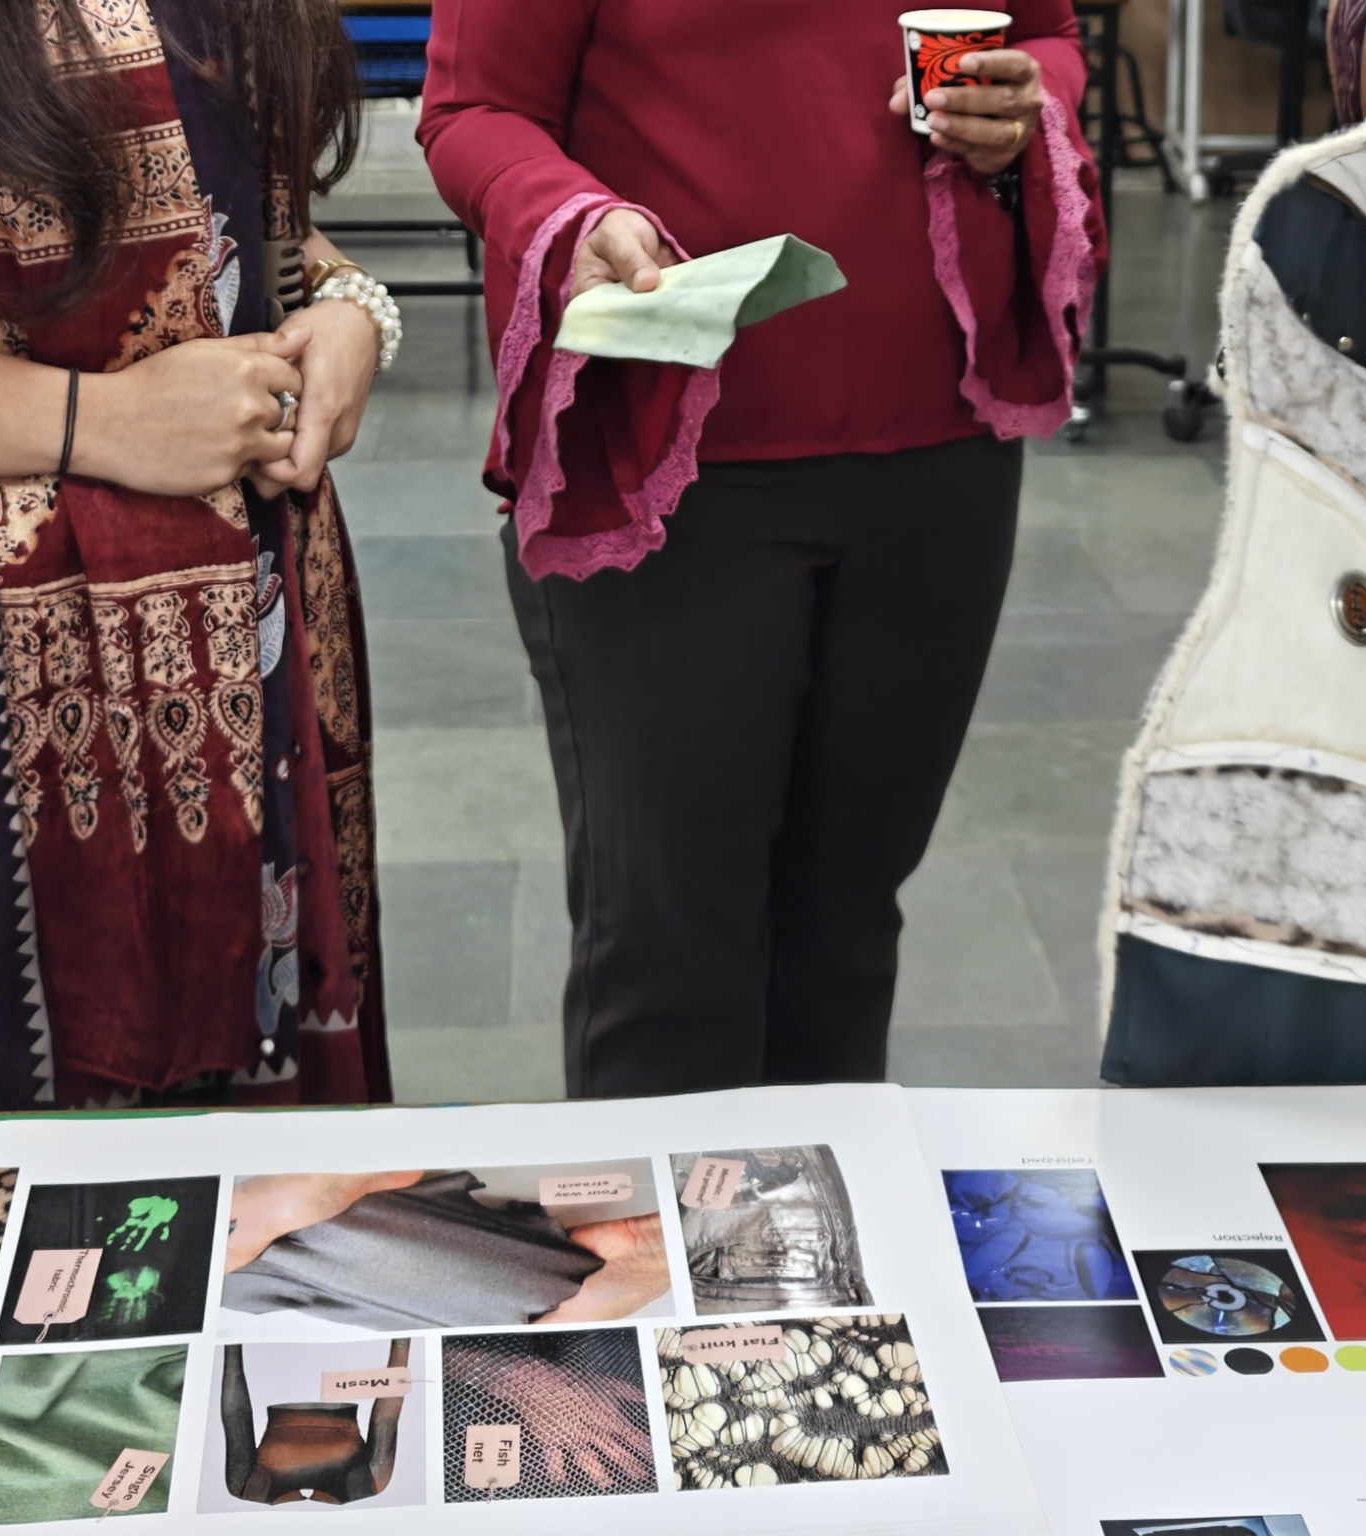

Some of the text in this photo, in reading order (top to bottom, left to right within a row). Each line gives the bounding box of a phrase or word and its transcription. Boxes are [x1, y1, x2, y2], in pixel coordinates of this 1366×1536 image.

[1213, 1232, 1283, 1242] Rejection
[698, 1337, 779, 1350] Flat knit
[335, 1378, 389, 1389] Mesh
[472, 1442, 484, 1463] net
[497, 1440, 513, 1466] Fish
[101, 1461, 134, 1499] Jersey
[123, 1466, 155, 1501] Single
